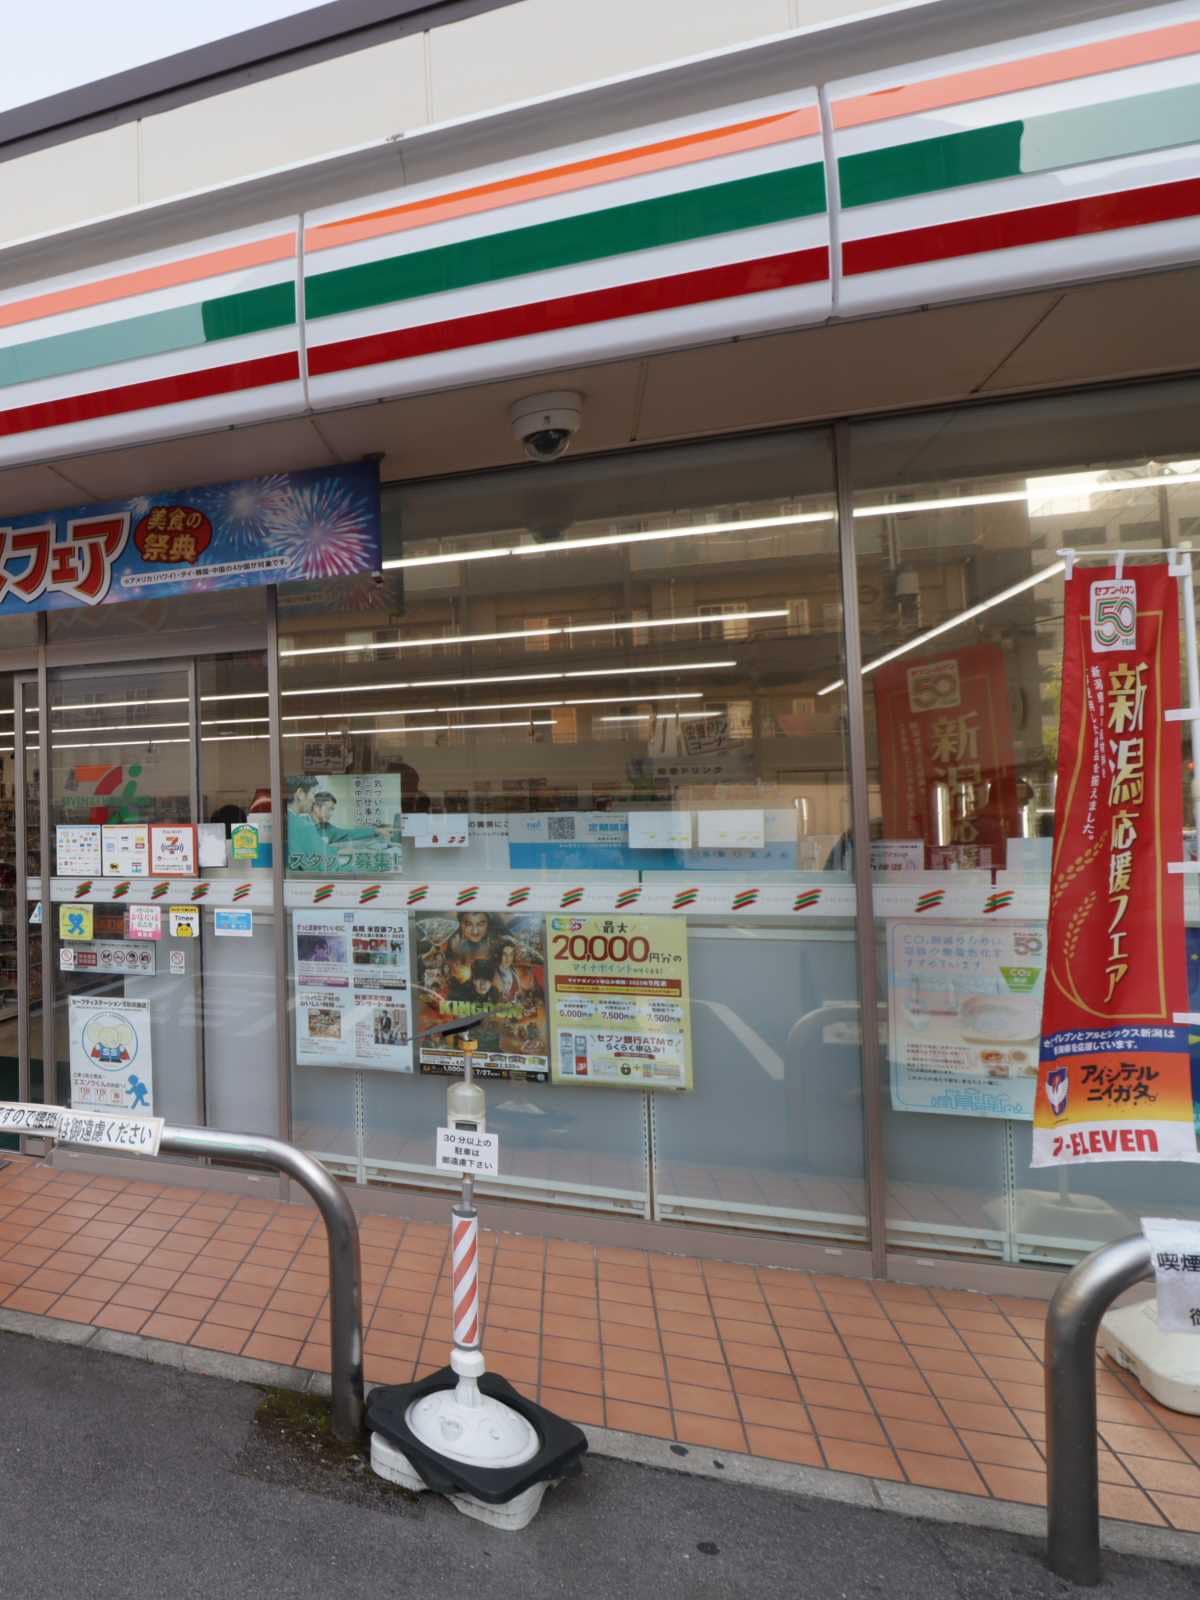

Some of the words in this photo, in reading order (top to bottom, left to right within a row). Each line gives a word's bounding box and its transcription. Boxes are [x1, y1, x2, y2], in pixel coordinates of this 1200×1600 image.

[148, 508, 202, 531] 美食の
[143, 533, 196, 561] 祭典
[1094, 600, 1135, 647] 50
[1106, 660, 1150, 1004] 新潟応援フェア
[603, 920, 629, 934] 最大
[1081, 1062, 1159, 1085] アイシテル
[443, 1134, 492, 1147] 30分以上の
[454, 1146, 480, 1157] 駐車は
[442, 1156, 493, 1169] 御遠慮下さい
